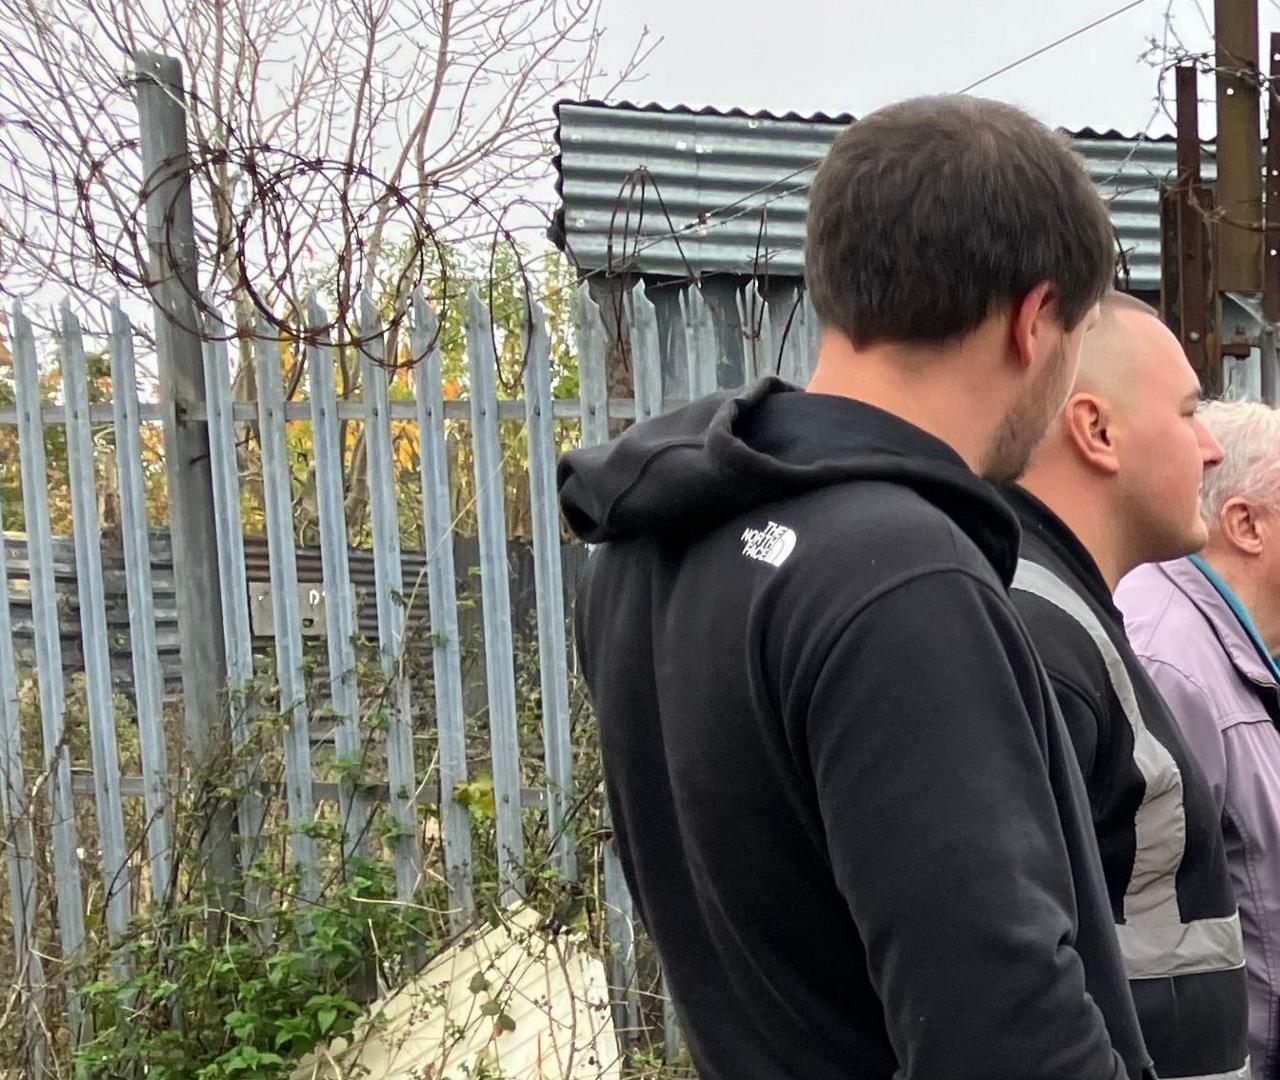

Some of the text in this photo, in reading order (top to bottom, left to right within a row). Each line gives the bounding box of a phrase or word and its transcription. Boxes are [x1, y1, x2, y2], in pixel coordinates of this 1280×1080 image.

[740, 527, 776, 550] NORTH
[763, 520, 788, 538] THE
[742, 542, 772, 562] FACE
